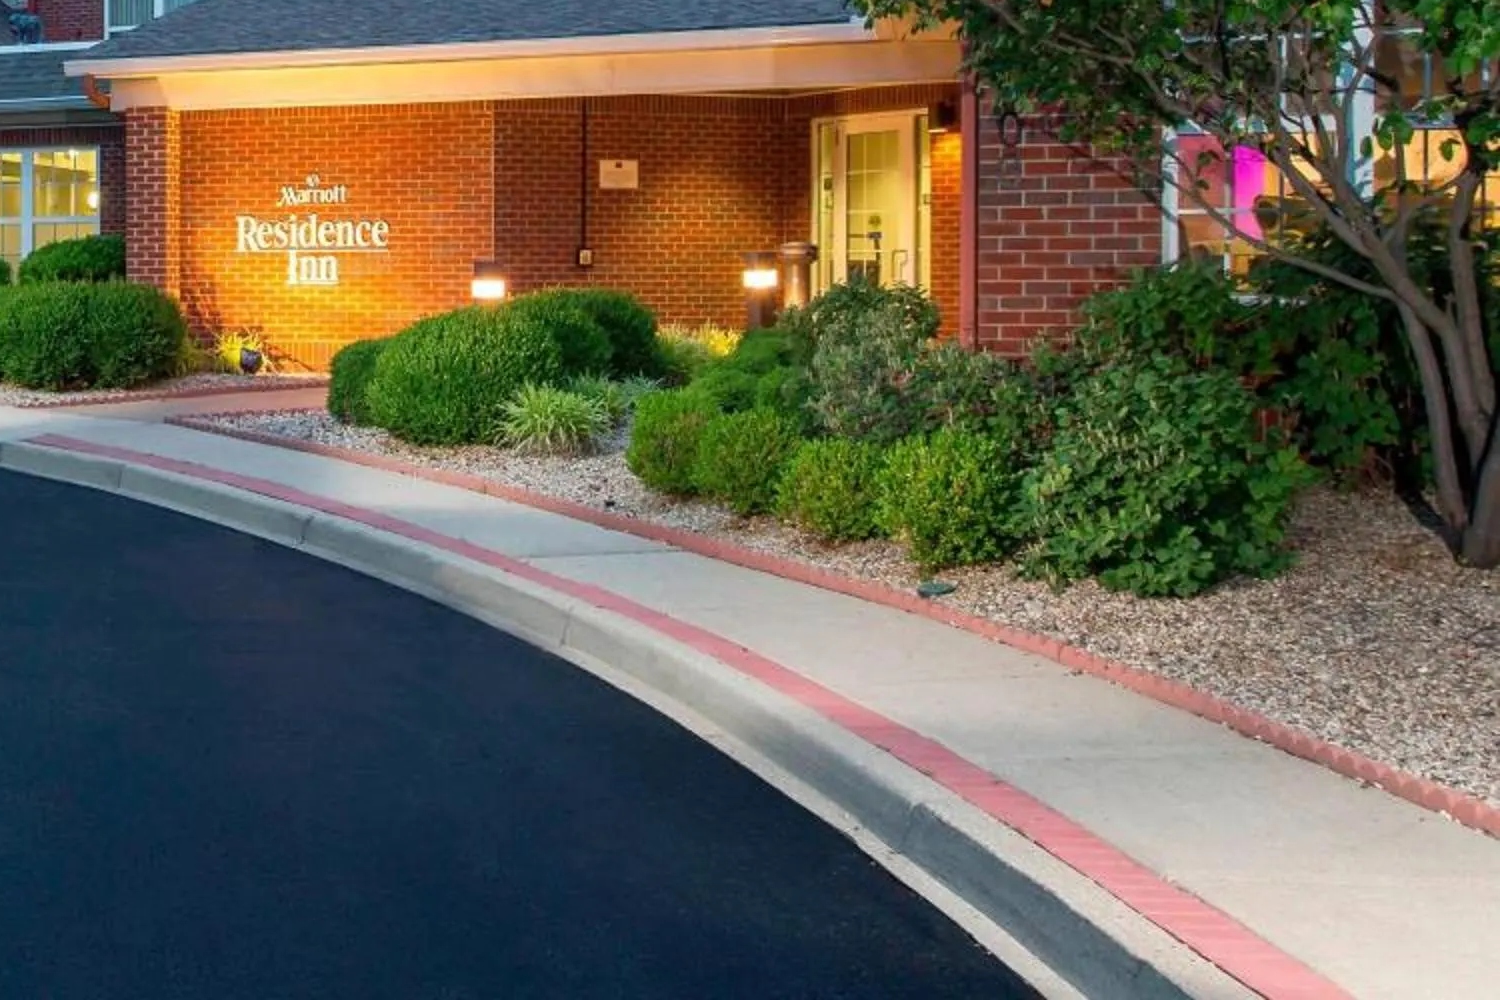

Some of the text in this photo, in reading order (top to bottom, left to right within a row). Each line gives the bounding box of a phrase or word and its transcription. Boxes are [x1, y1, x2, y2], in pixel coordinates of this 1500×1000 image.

[276, 184, 347, 207] Marriott
[236, 213, 389, 252] Residence
[286, 249, 338, 285] Inn
